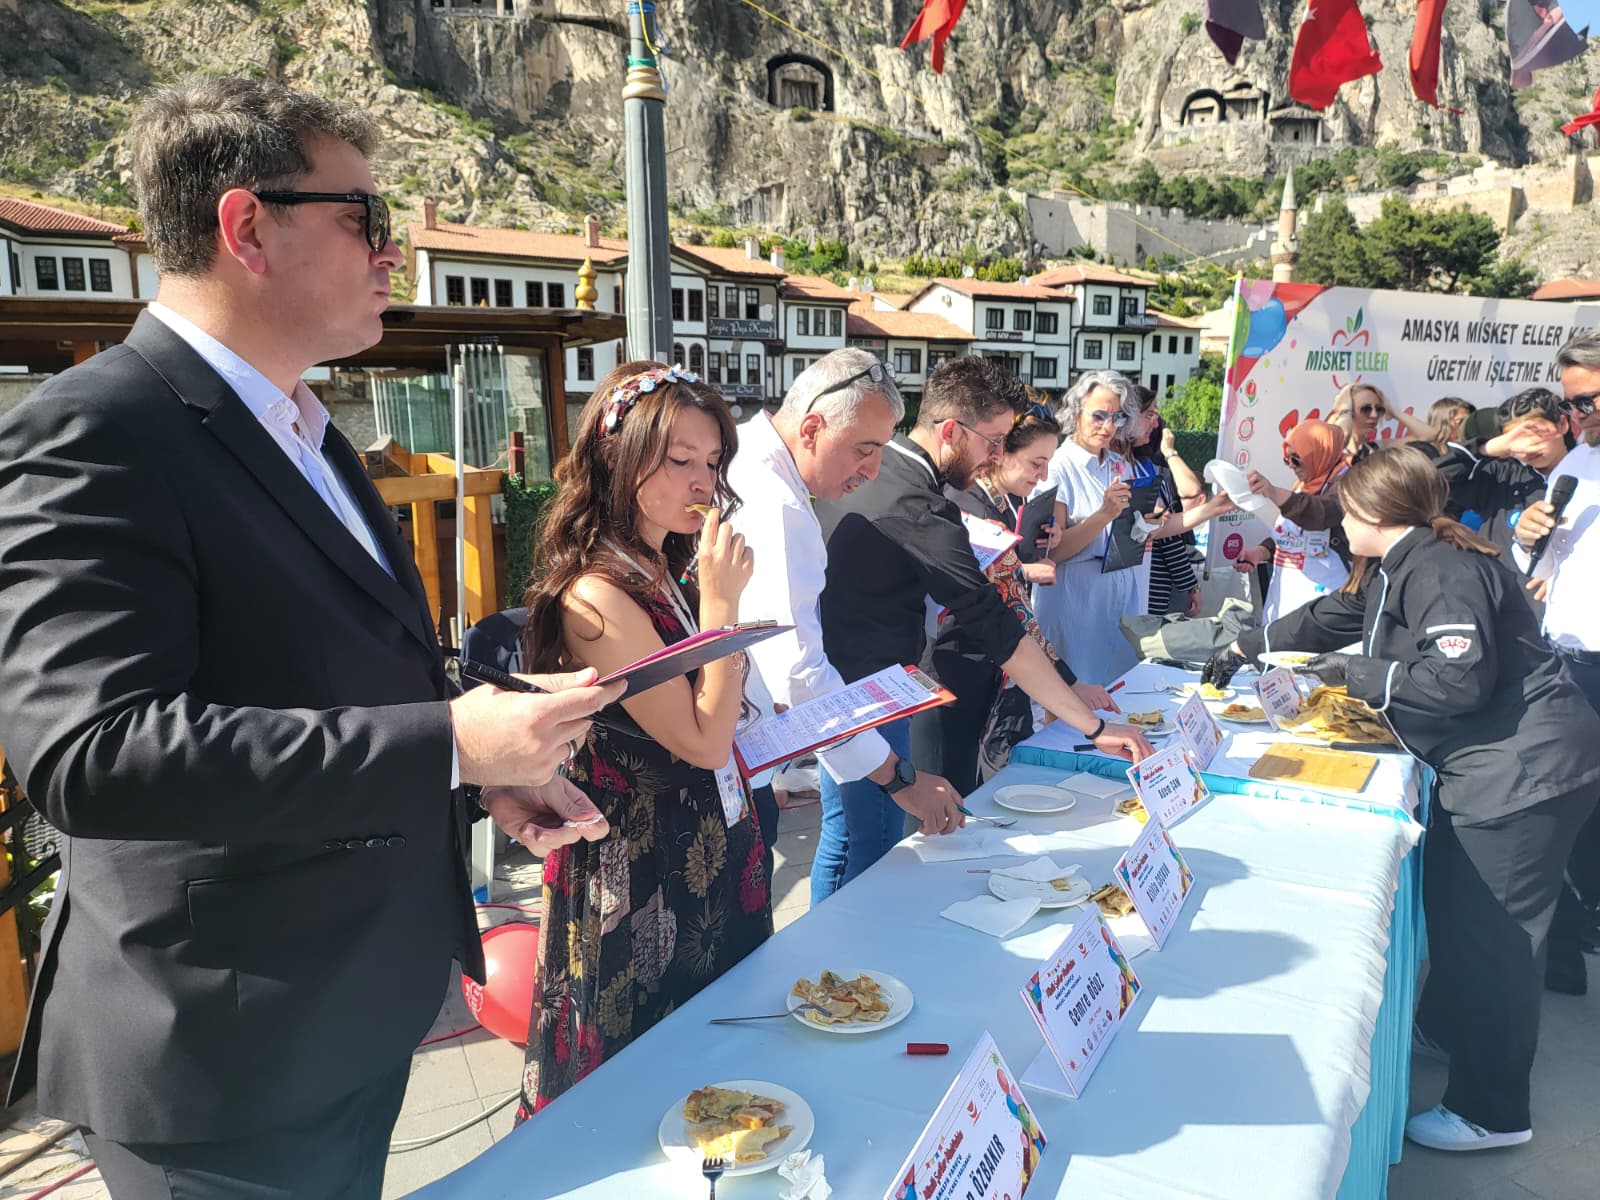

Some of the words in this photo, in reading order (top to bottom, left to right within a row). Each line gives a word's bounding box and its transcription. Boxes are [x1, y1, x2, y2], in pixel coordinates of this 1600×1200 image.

[1401, 318, 1460, 343] AMASYA
[1466, 316, 1519, 345] MİSKET
[1522, 324, 1563, 346] ELLER
[1305, 346, 1353, 371] MİSKET
[1355, 351, 1389, 372] ELLER
[1427, 355, 1482, 382] ÜRETİM
[1485, 355, 1543, 388] İŞLETME
[1068, 993, 1091, 1027] Cemre
[969, 1133, 1005, 1197] ÖZBAKIR
